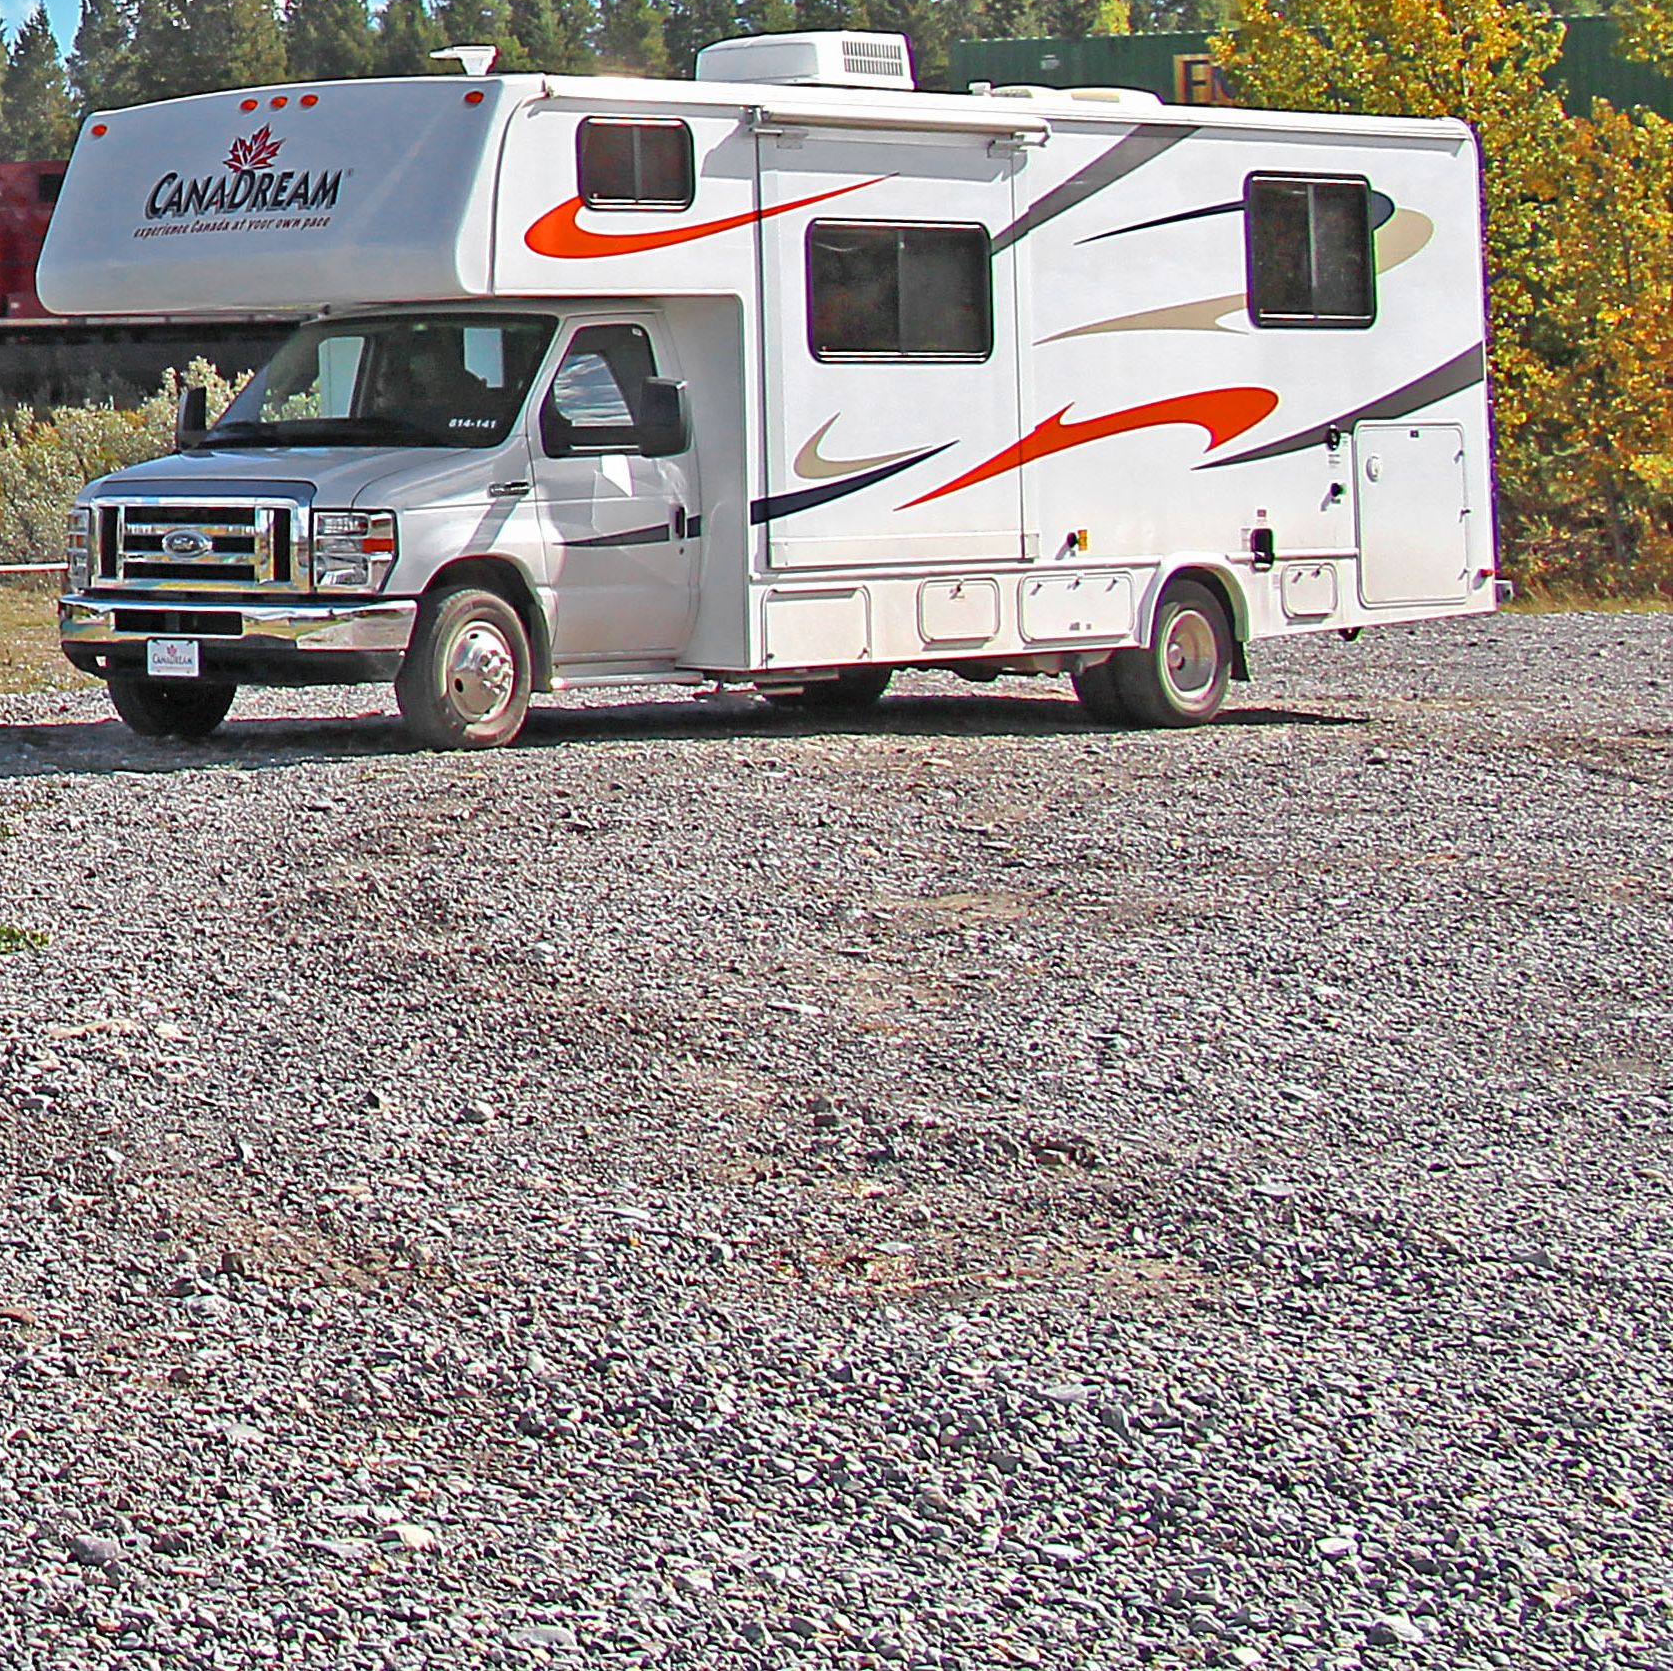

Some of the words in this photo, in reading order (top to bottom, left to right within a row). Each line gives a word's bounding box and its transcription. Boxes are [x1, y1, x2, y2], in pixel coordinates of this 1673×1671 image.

[133, 222, 189, 240] experience
[190, 218, 230, 234] Canada
[230, 218, 246, 231] at
[245, 217, 274, 233] your
[274, 217, 301, 230] own
[300, 215, 331, 231] pace
[448, 418, 497, 429] 814-141
